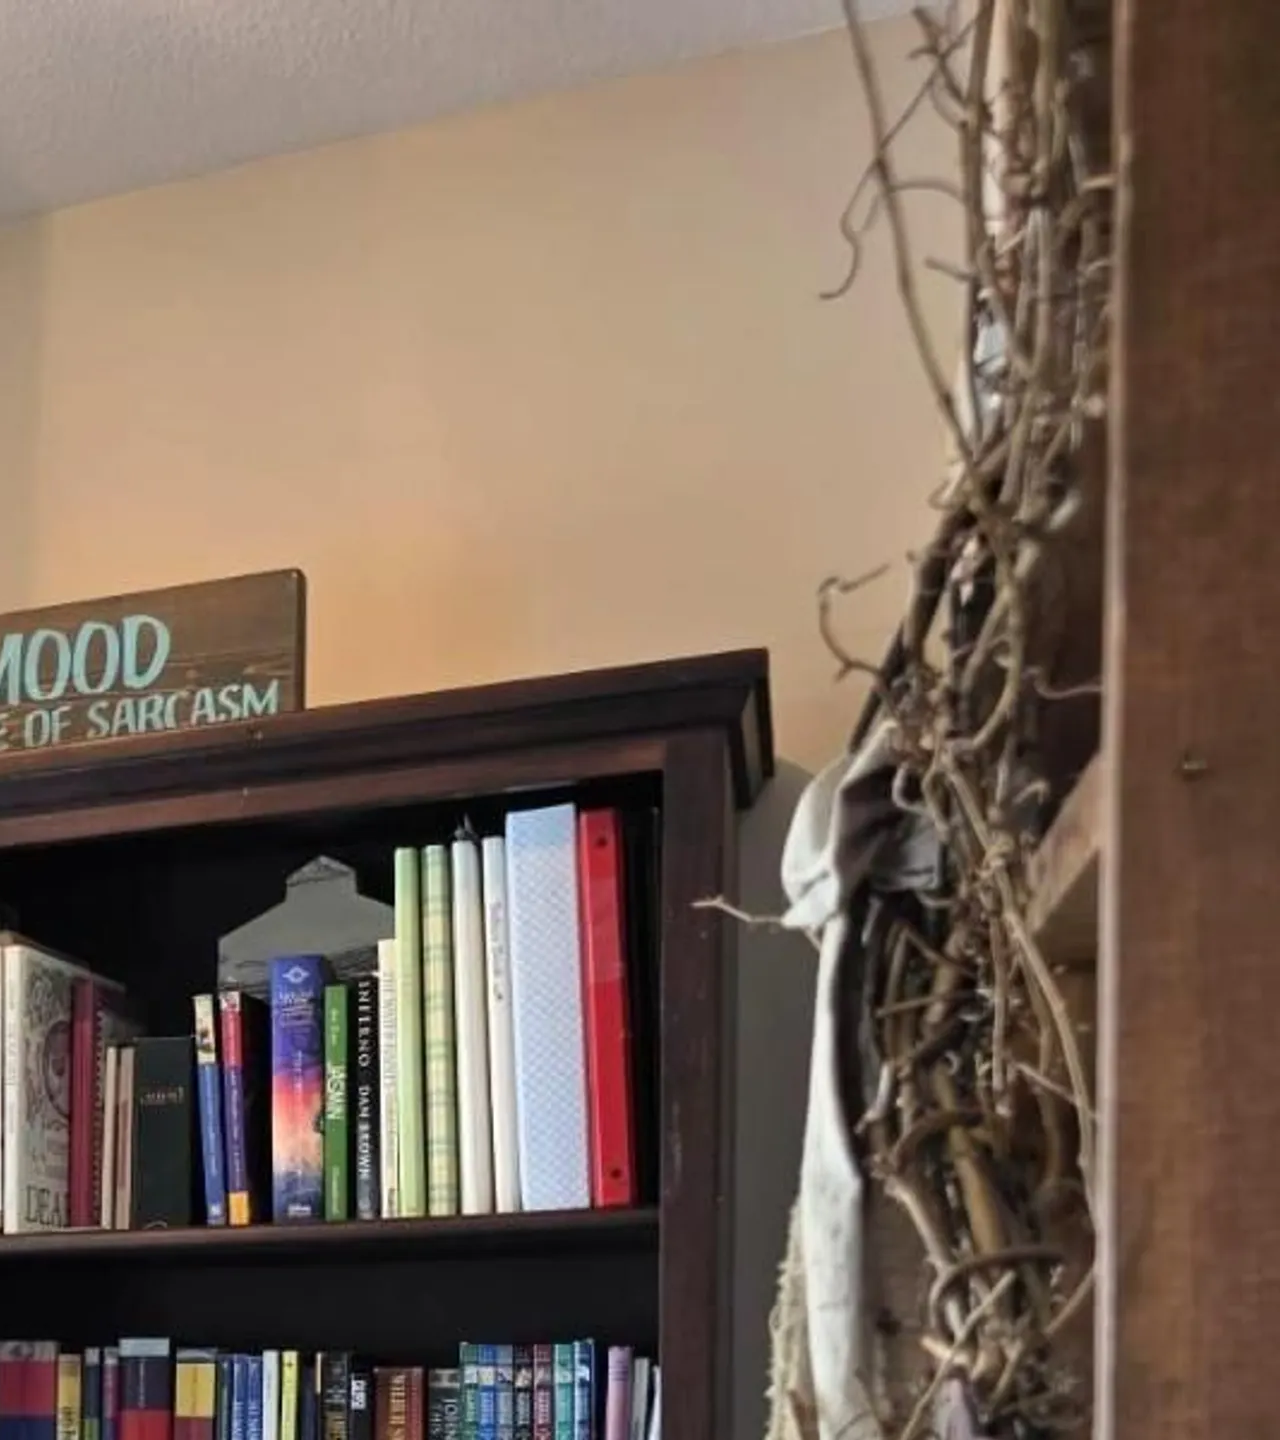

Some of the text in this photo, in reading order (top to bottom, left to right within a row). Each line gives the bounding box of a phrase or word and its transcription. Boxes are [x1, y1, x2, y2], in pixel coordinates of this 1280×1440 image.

[24, 707, 71, 750] OF
[87, 681, 282, 740] SARCASM
[326, 1061, 347, 1121] JASMIN
[358, 981, 371, 1179] INFERNO DAN BROWN
[442, 1397, 459, 1440] JOHN
